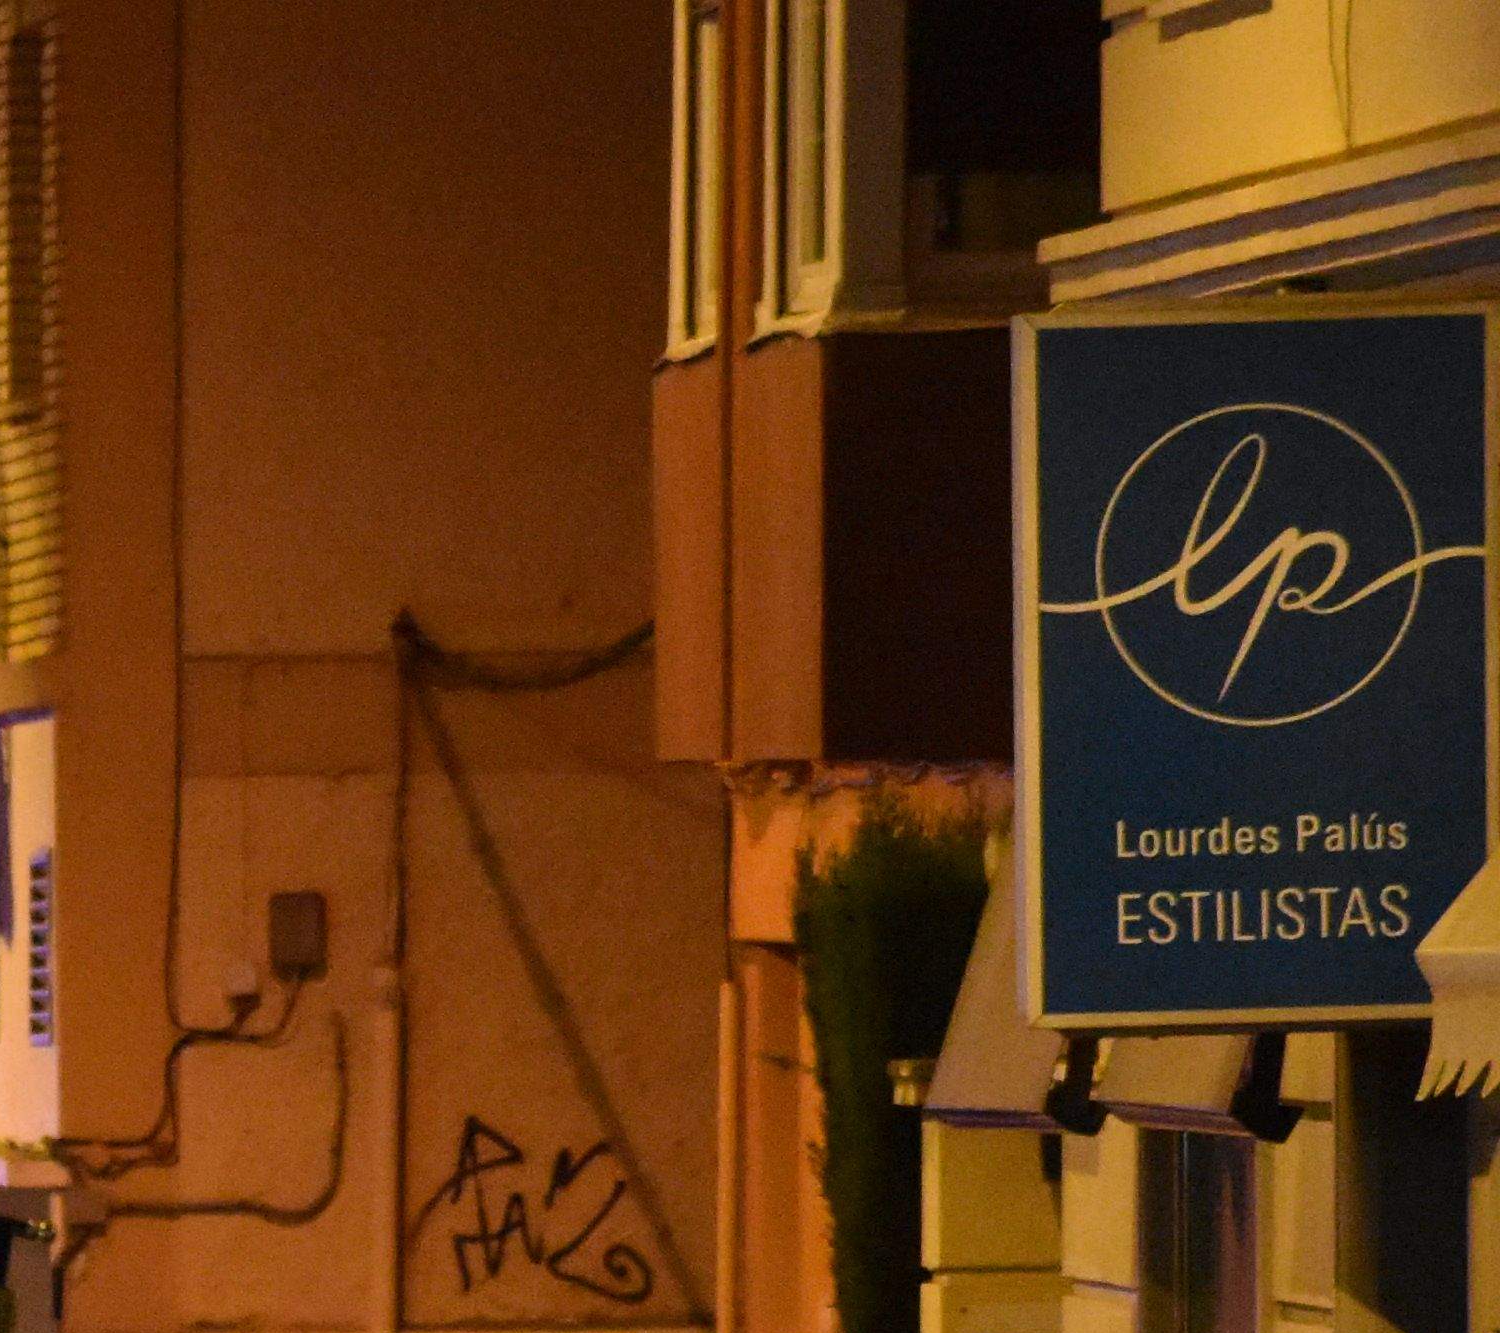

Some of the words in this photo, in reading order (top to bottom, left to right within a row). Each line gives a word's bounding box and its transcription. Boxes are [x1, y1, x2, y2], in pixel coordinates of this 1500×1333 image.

[1115, 816, 1281, 860] Lourdes
[1296, 810, 1409, 853] Palús
[1115, 885, 1412, 947] ESTILISTAS
